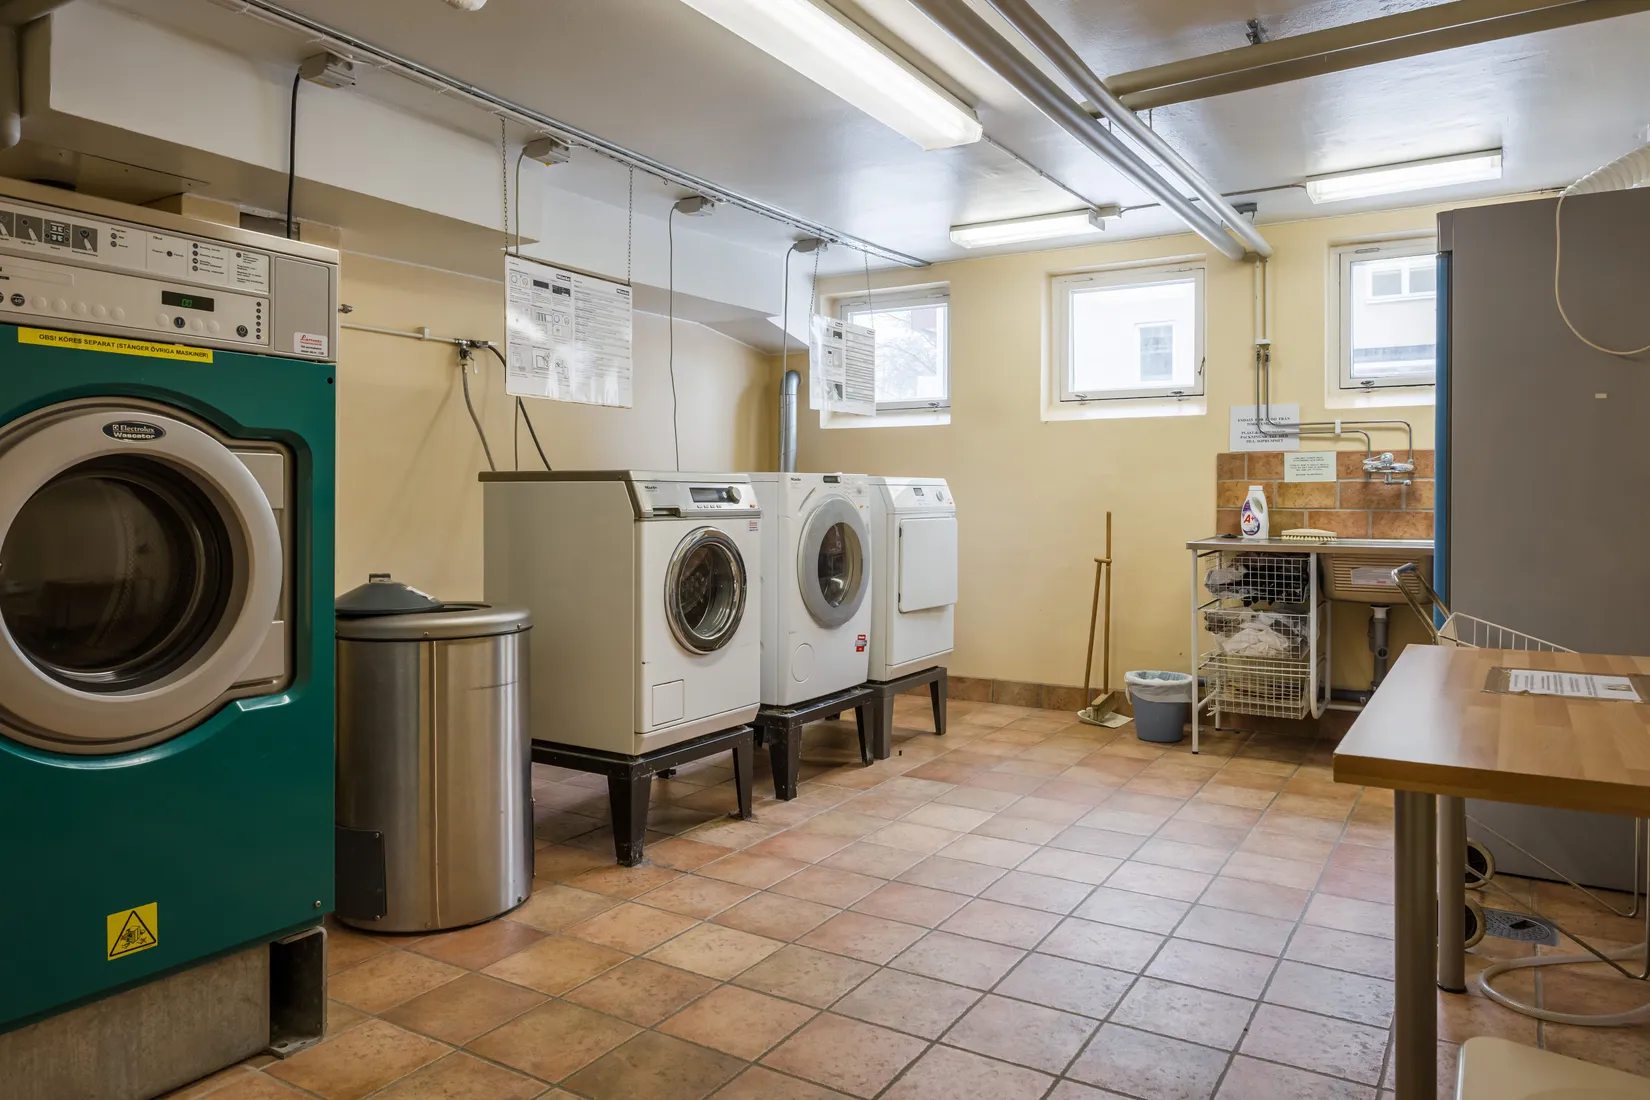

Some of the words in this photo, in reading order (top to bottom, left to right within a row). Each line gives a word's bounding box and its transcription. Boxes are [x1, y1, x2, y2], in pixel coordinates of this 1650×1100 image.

[58, 336, 83, 344] KÖRES
[83, 339, 115, 348] SEPARAT
[116, 343, 150, 352] (STÄNGER
[150, 346, 175, 354] ÖVRIGA
[175, 349, 209, 358] MASKINER)
[120, 424, 155, 434] Electrolux
[1243, 514, 1255, 523] A+
